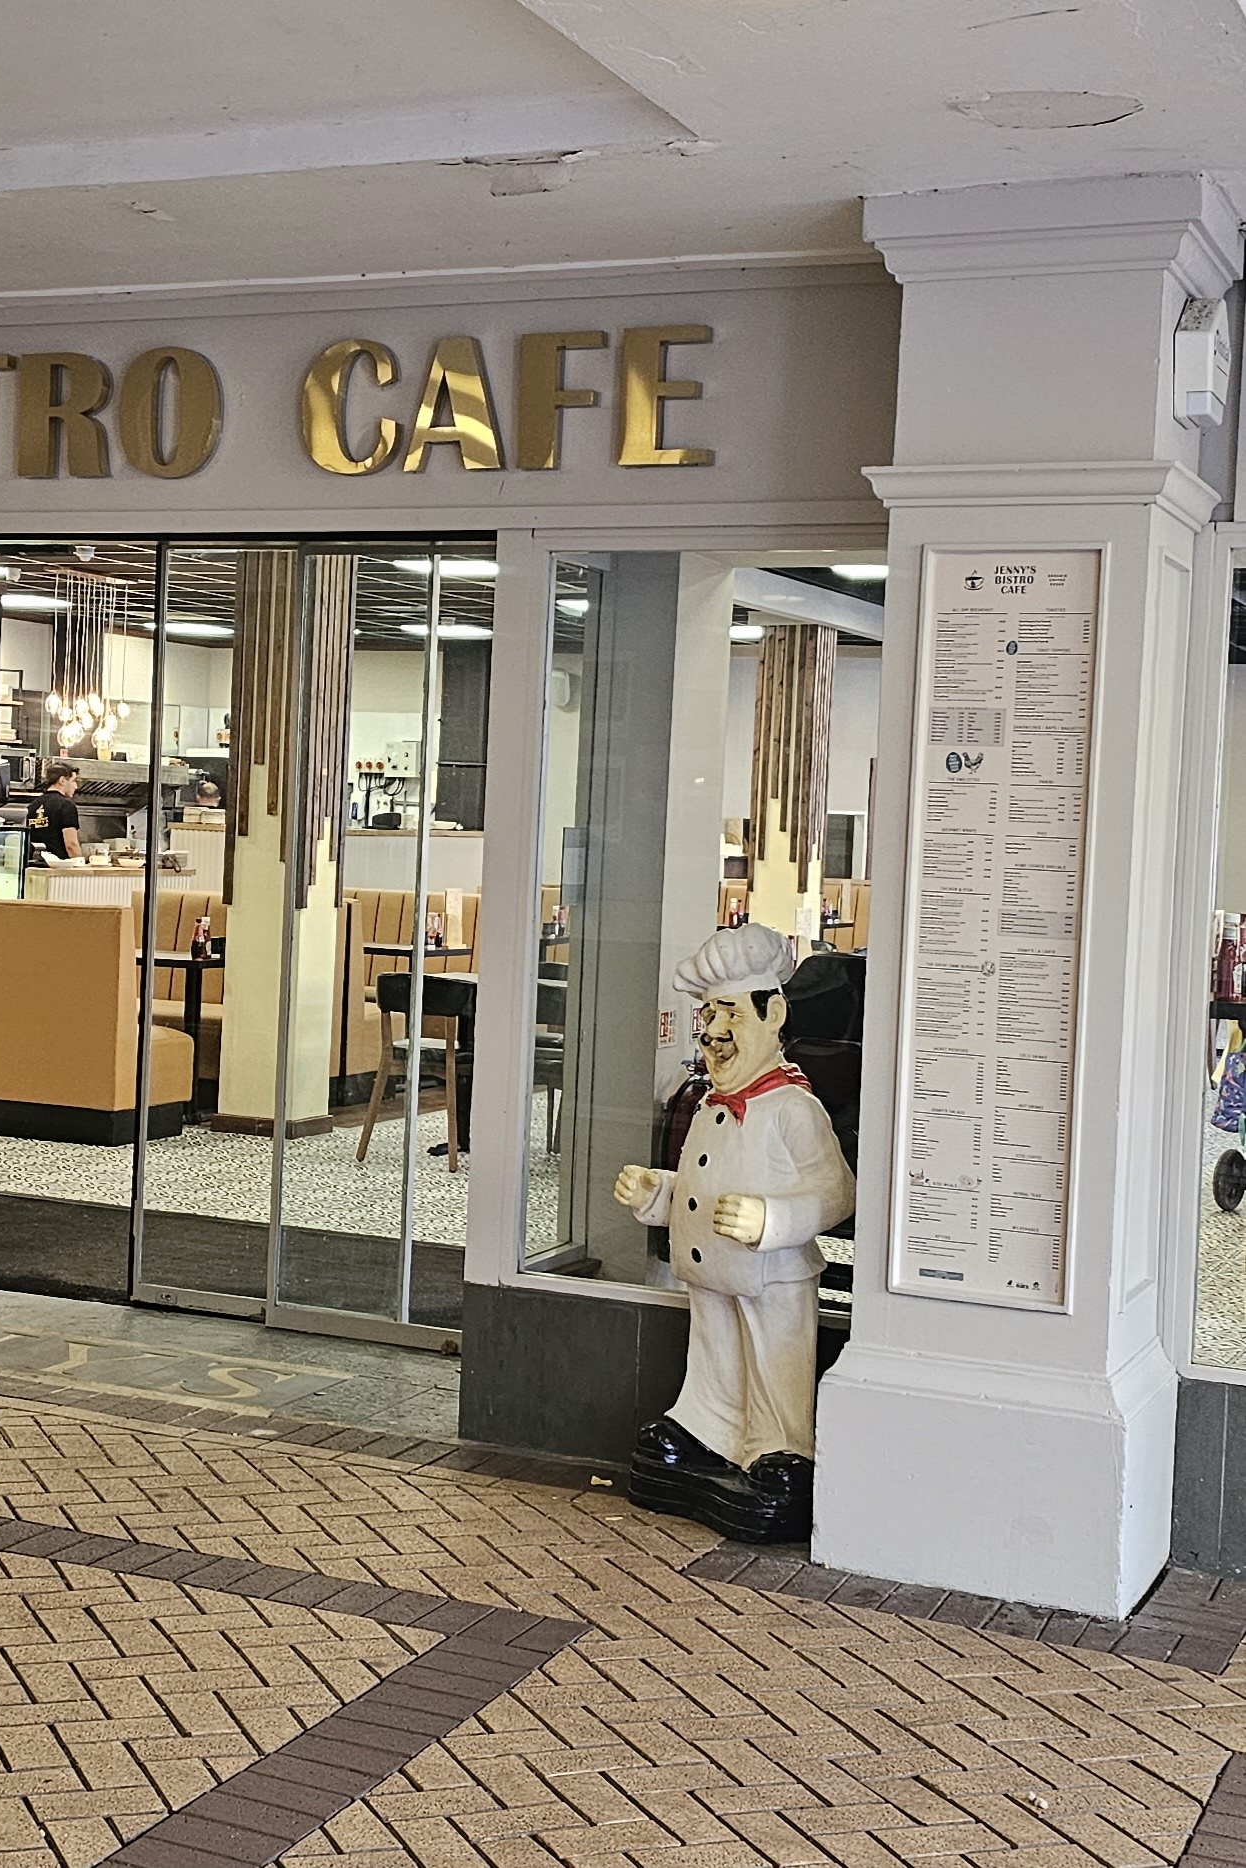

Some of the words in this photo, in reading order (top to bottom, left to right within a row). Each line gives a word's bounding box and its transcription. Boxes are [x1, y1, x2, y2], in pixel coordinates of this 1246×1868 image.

[298, 324, 715, 477] CAFE
[994, 565, 1037, 575] JENNY'S
[994, 575, 1034, 584] BISTRO
[1000, 585, 1027, 594] CAFE
